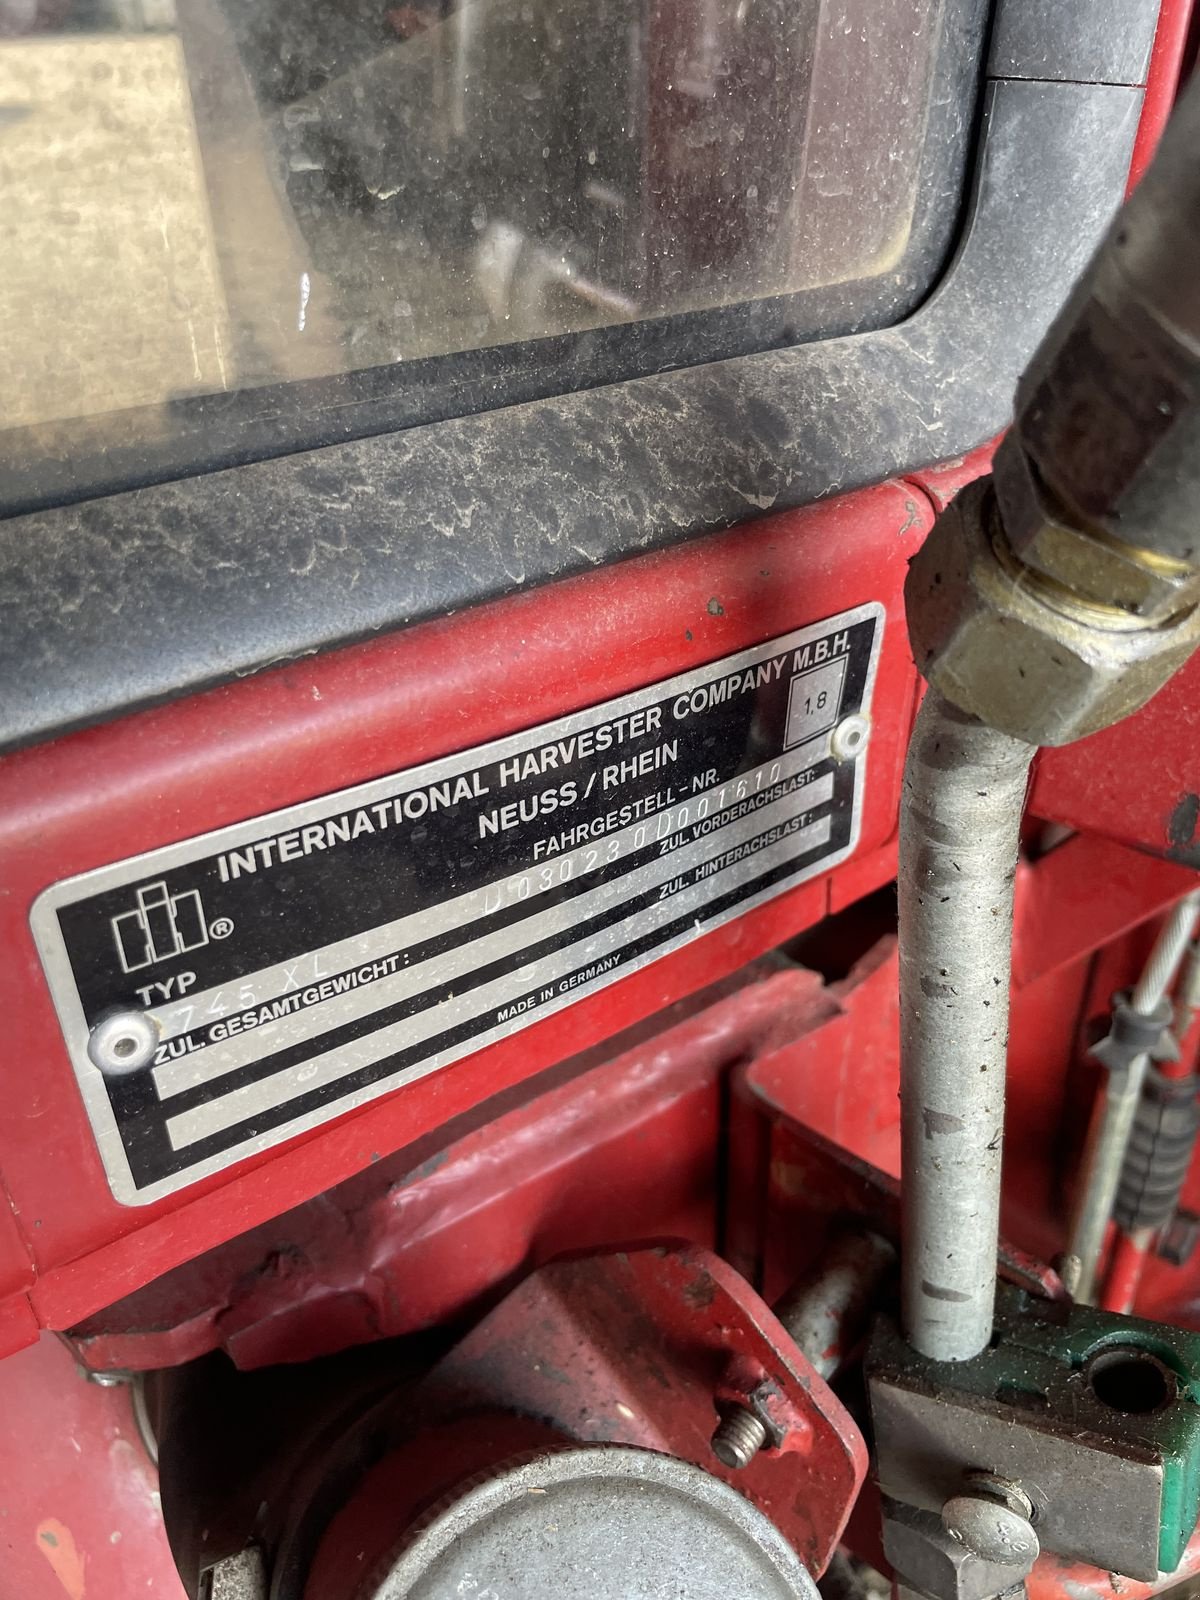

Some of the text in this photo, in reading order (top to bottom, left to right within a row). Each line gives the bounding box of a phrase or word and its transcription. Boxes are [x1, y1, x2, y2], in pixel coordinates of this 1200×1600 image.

[217, 630, 851, 883] INTERNATIONAL HARVESTER COMPANY M.B.H.
[659, 768, 815, 855] ZUL. VORDERACHSLAST:
[659, 879, 690, 900] ZUL.
[135, 971, 197, 1006] TYP
[497, 954, 622, 1022] MADE IN GERMANY
[154, 1032, 206, 1065] ZUL.
